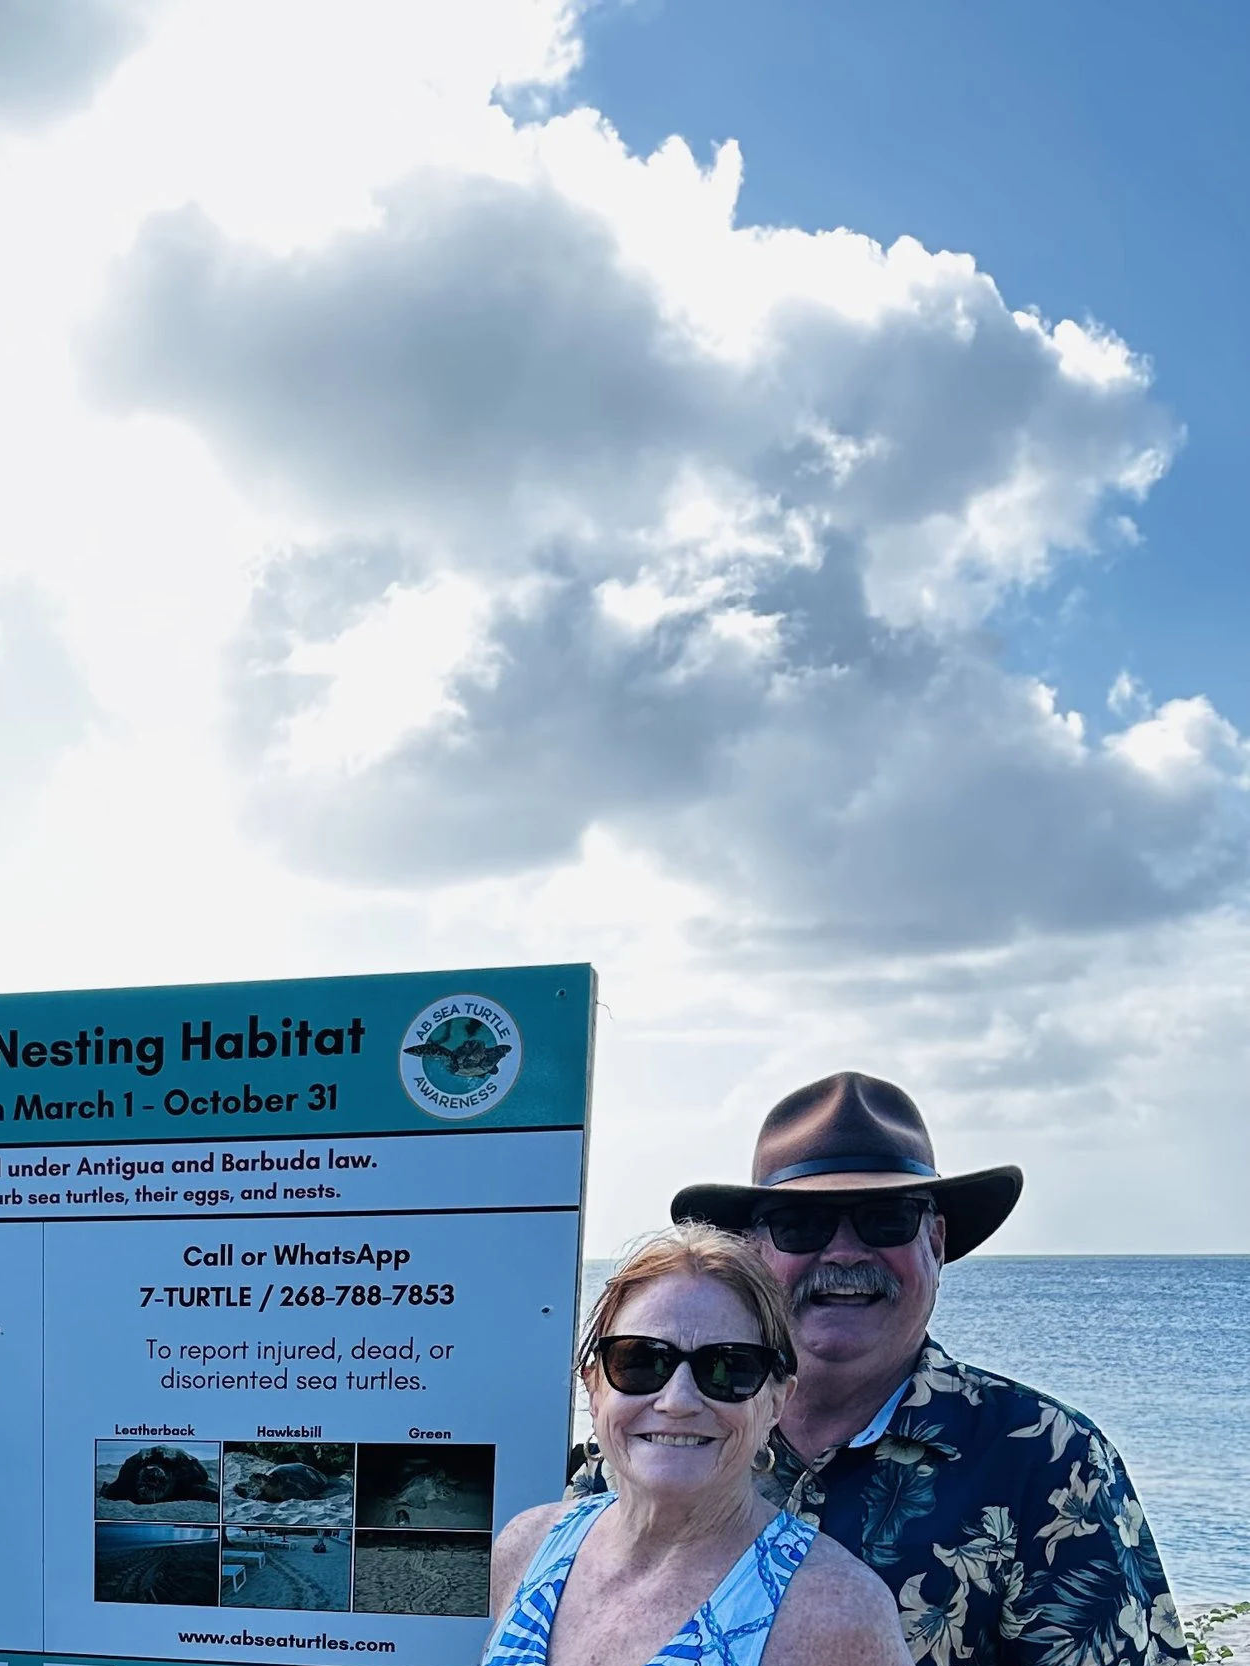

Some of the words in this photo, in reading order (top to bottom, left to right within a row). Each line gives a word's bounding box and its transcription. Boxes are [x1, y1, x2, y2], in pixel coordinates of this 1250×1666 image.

[416, 1020, 432, 1041] AB
[432, 1004, 460, 1023] SEA
[464, 1002, 511, 1040] TURTLE
[181, 1015, 365, 1061] Habitat
[13, 1090, 114, 1121] March
[124, 1091, 133, 1117] 1
[163, 1084, 298, 1116] October
[308, 1083, 337, 1111] 31
[413, 1076, 498, 1108] AWARENESS
[8, 1156, 70, 1177] under
[76, 1156, 164, 1180] Antigua
[171, 1152, 214, 1173] and
[222, 1149, 320, 1172] Barbuda
[329, 1148, 378, 1170] law.
[28, 1192, 60, 1204] sea
[66, 1186, 129, 1205] turtles,
[135, 1185, 178, 1203] their
[183, 1188, 234, 1206] eggs,
[240, 1182, 277, 1200] and
[283, 1184, 341, 1200] nests.
[183, 1244, 233, 1267] Call
[241, 1250, 268, 1266] or
[273, 1242, 411, 1271] WhatsApp
[140, 1286, 252, 1308] 7-TURTLE
[258, 1284, 274, 1312] /
[279, 1284, 455, 1307] 268-788-7853
[146, 1338, 171, 1360] To
[180, 1340, 249, 1366] report
[257, 1336, 342, 1366] injured,
[351, 1336, 421, 1363] dead,
[429, 1343, 454, 1360] or
[160, 1367, 288, 1390] disoriented
[296, 1374, 337, 1391] sea
[345, 1368, 427, 1391] turtles.
[115, 1423, 195, 1437] Leatherback
[257, 1425, 322, 1439] Hawksbill
[408, 1427, 452, 1440] Green
[178, 1629, 396, 1653] www.abseaturtles.com
